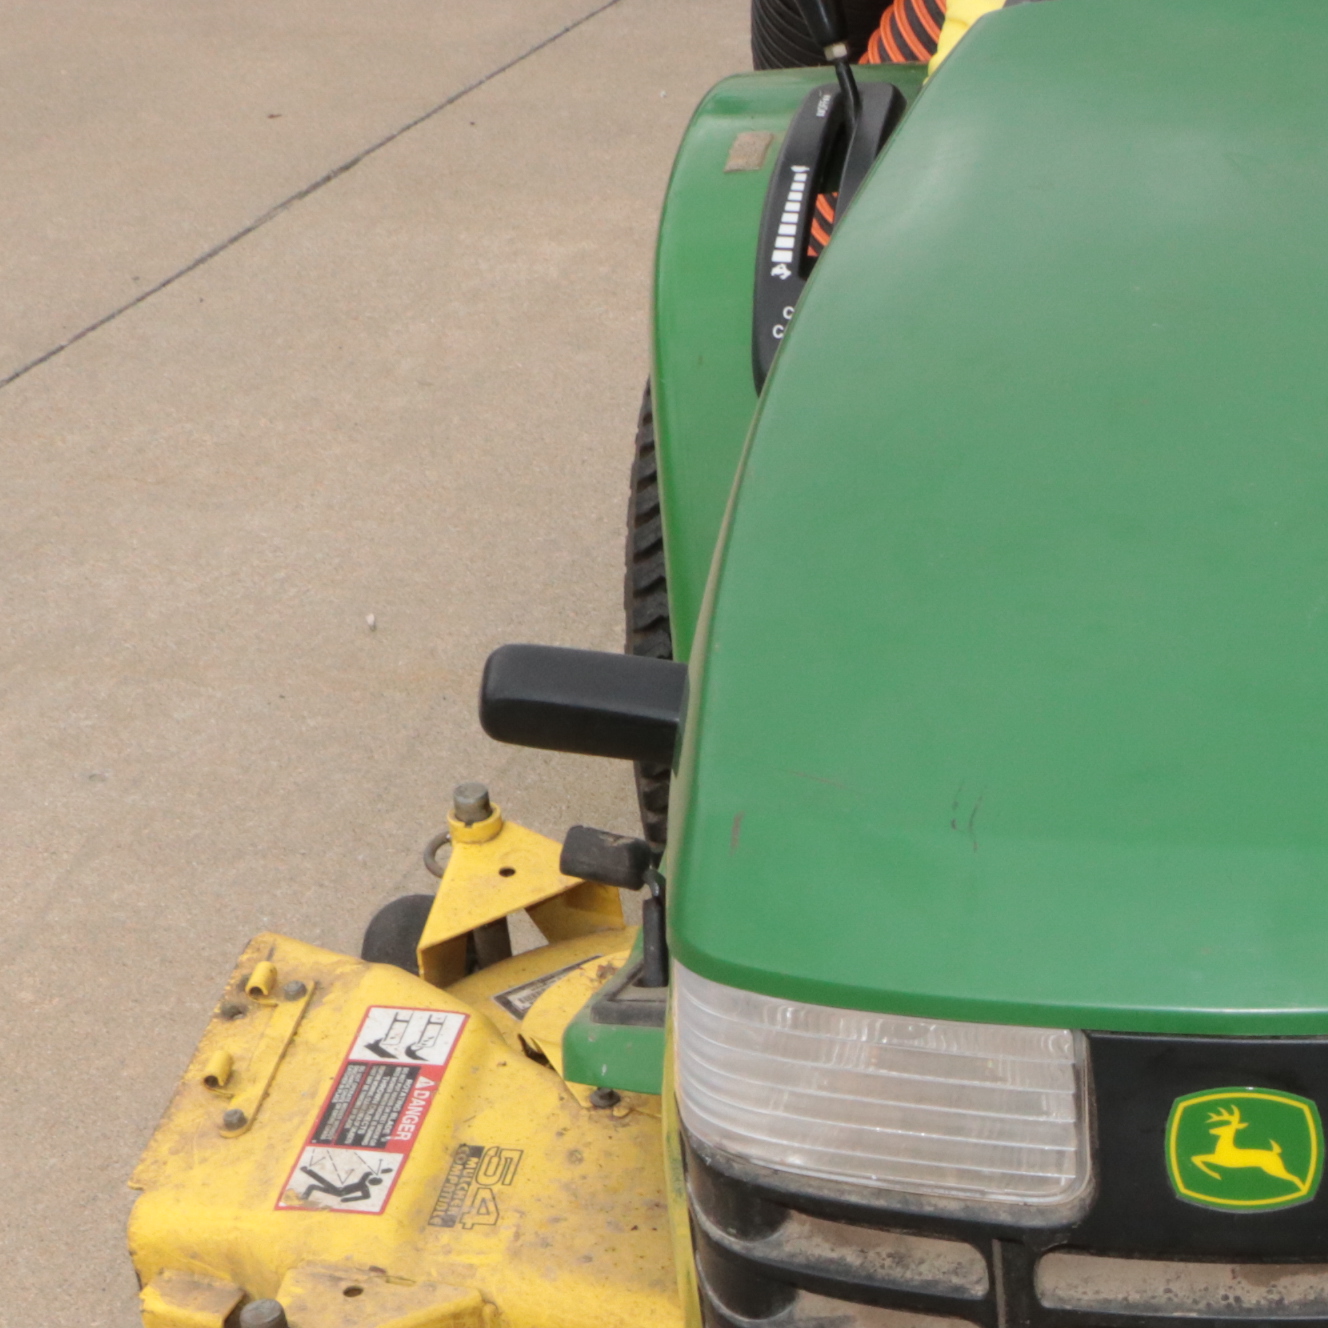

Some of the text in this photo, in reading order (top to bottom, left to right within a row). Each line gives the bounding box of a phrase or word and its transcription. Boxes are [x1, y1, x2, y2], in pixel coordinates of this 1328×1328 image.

[390, 1078, 413, 1112] ROTATING
[395, 1089, 431, 1140] DANGER
[445, 1156, 480, 1217] MULCHER
[459, 1146, 524, 1230] 54
